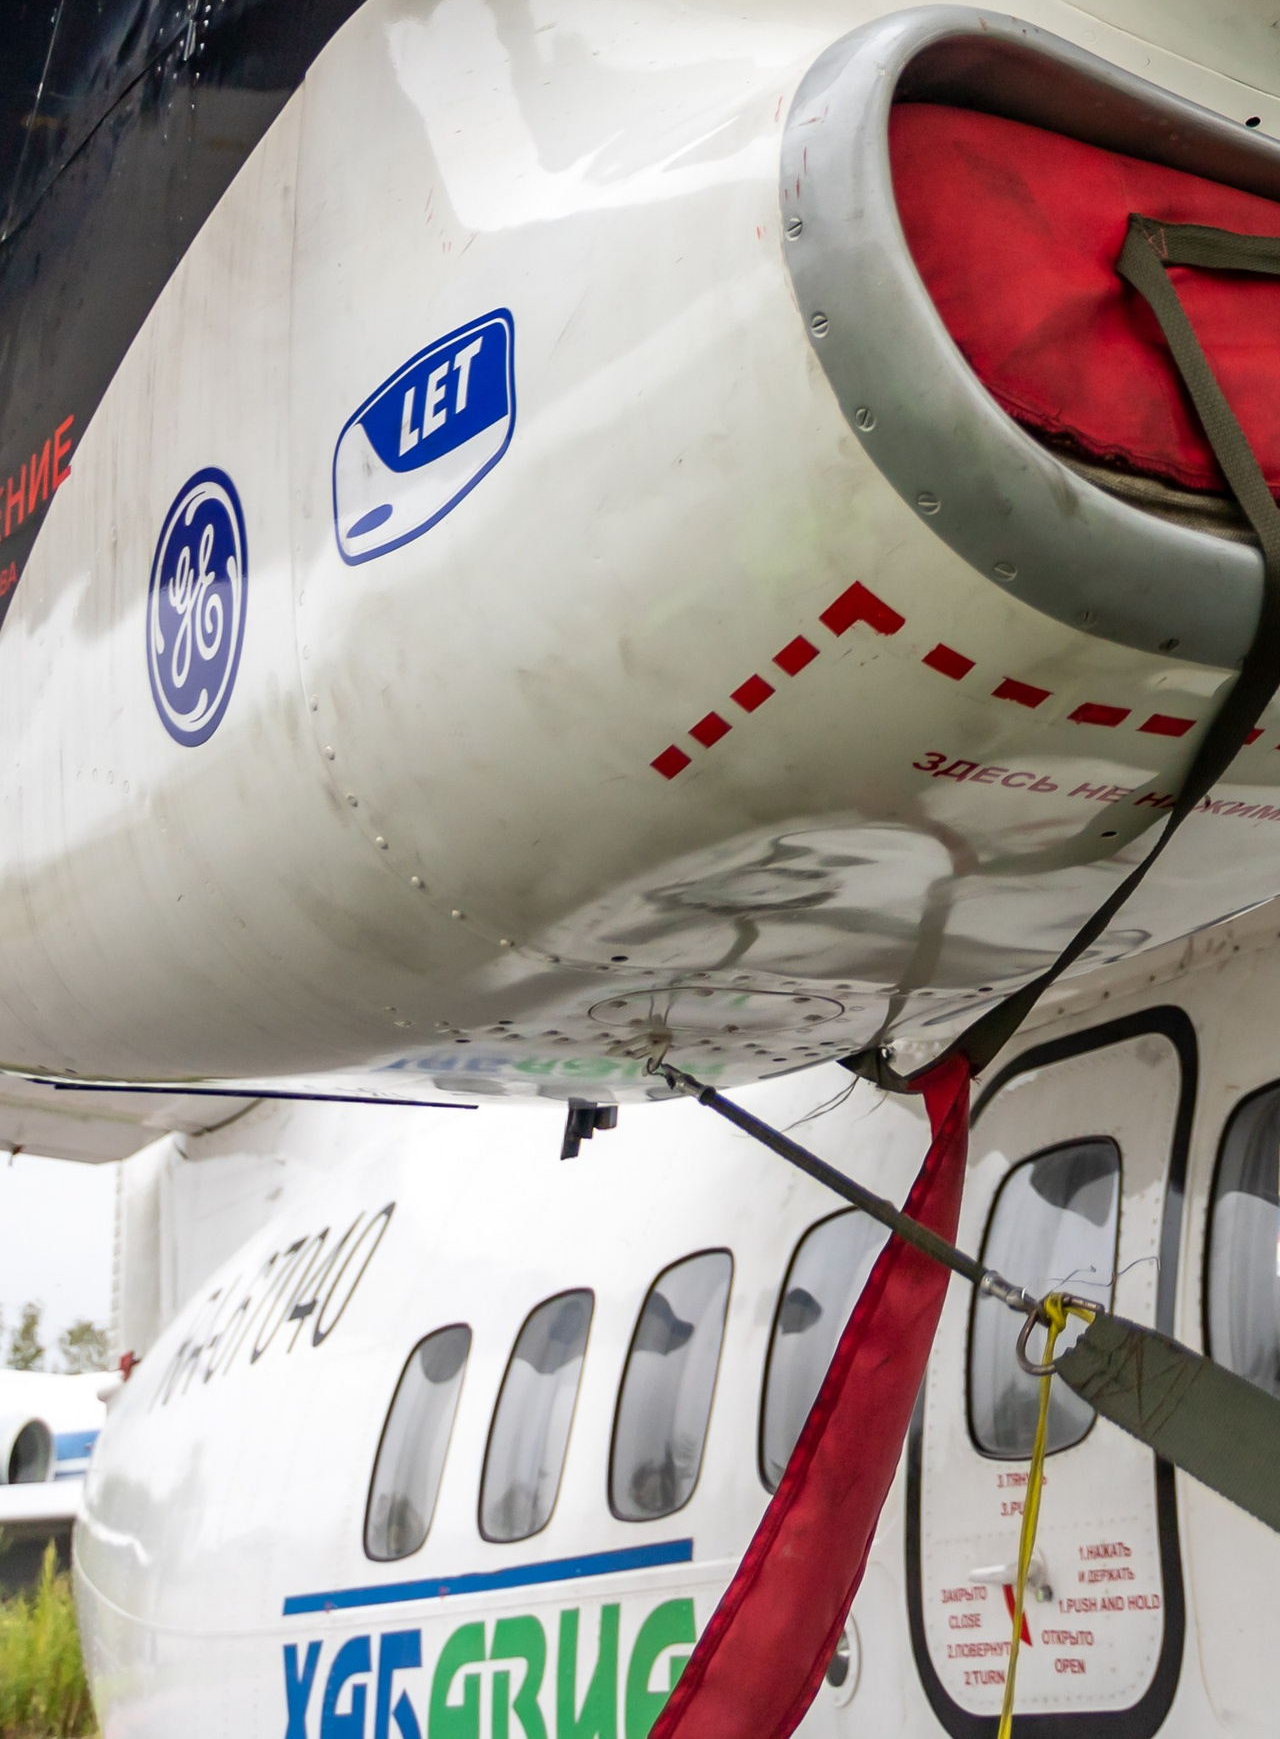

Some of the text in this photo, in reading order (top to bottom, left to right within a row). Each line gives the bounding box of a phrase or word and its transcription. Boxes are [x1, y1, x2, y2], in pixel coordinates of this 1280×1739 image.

[398, 336, 483, 457] LET
[0, 414, 75, 542] НИЕ
[913, 752, 1058, 793] ЗДЕСЬ
[1067, 782, 1135, 804] НЕ
[1088, 1567, 1135, 1583] ДЕРЖАТЬ
[941, 1586, 988, 1603] ЗАКРЫТО
[1059, 1593, 1160, 1613] 1.PUSH AND HOLD
[949, 1613, 982, 1629] CLOSE
[1042, 1629, 1094, 1646] ОТКРЫТО
[1055, 1658, 1086, 1674] OPEN
